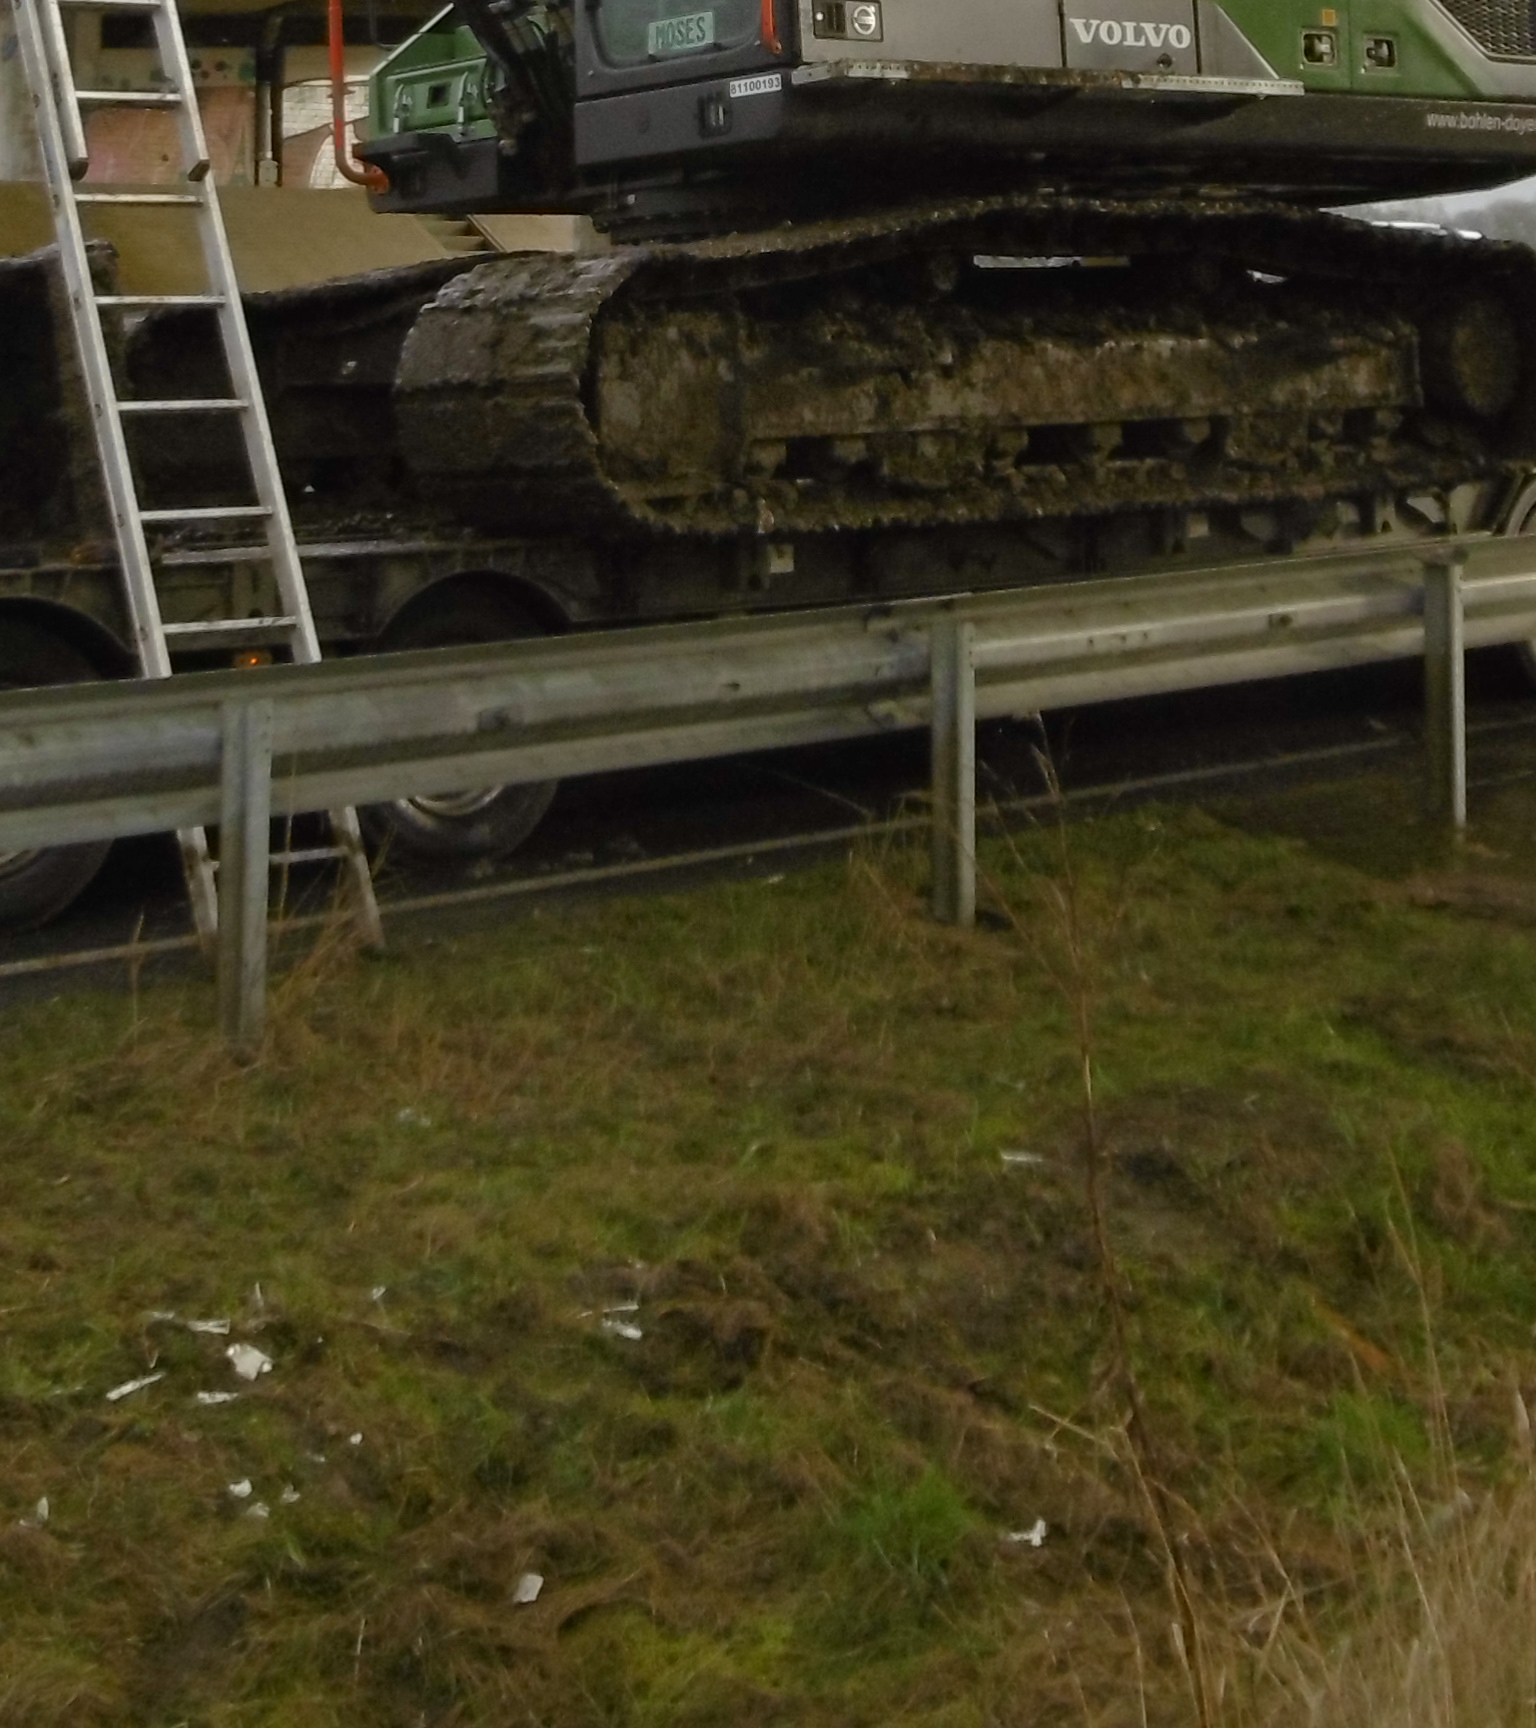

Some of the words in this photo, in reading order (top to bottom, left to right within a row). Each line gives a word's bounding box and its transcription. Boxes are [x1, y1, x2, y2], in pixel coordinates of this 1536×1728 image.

[655, 15, 706, 49] MOSES
[1070, 17, 1191, 50] VOLVO
[730, 77, 781, 95] 81100193
